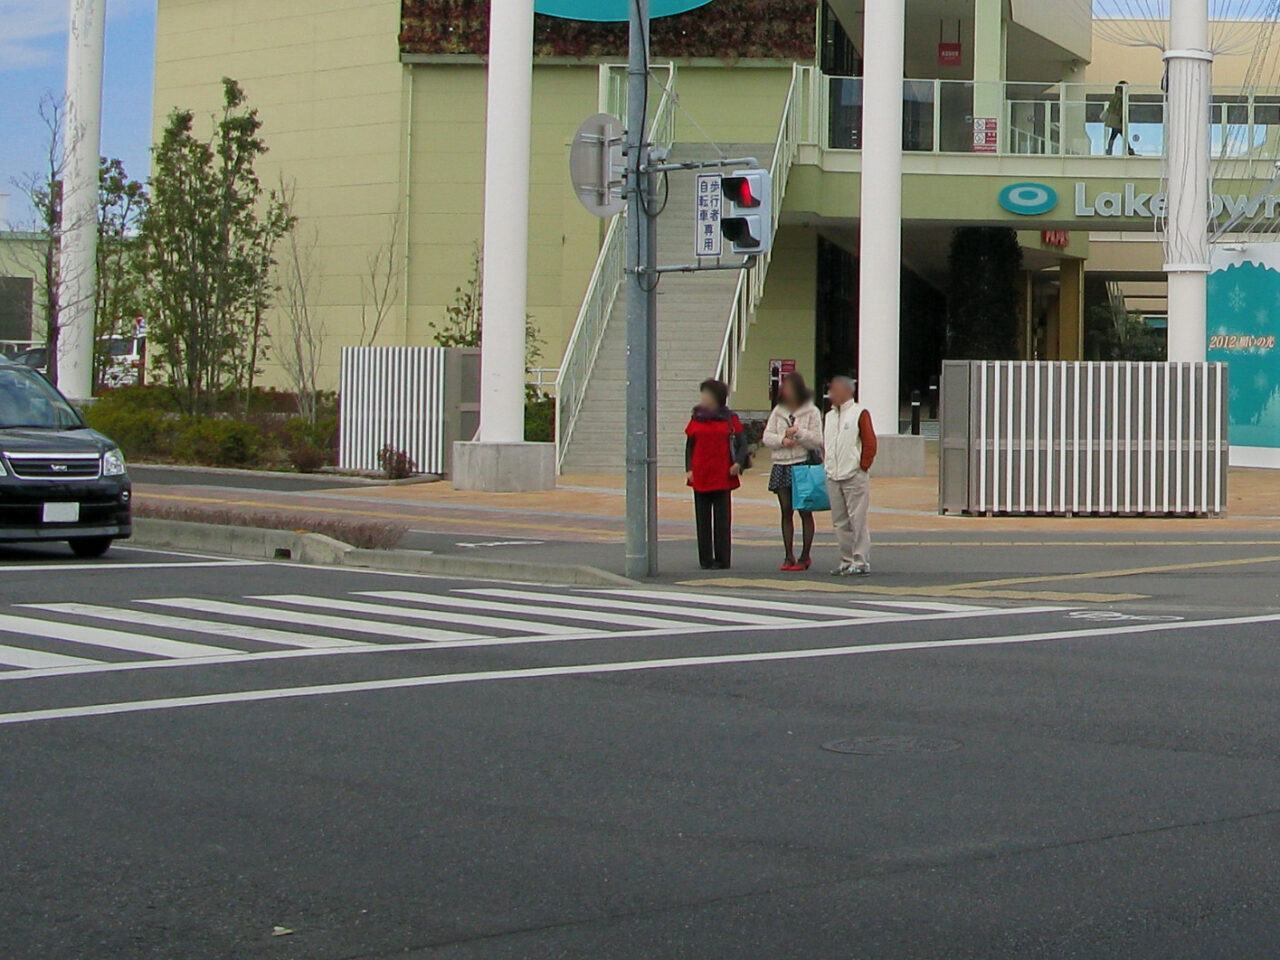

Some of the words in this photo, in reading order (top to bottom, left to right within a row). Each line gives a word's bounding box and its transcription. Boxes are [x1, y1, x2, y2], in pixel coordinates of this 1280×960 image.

[699, 180, 709, 222] 自転車
[710, 180, 720, 222] 歩行者
[703, 223, 714, 251] 専用
